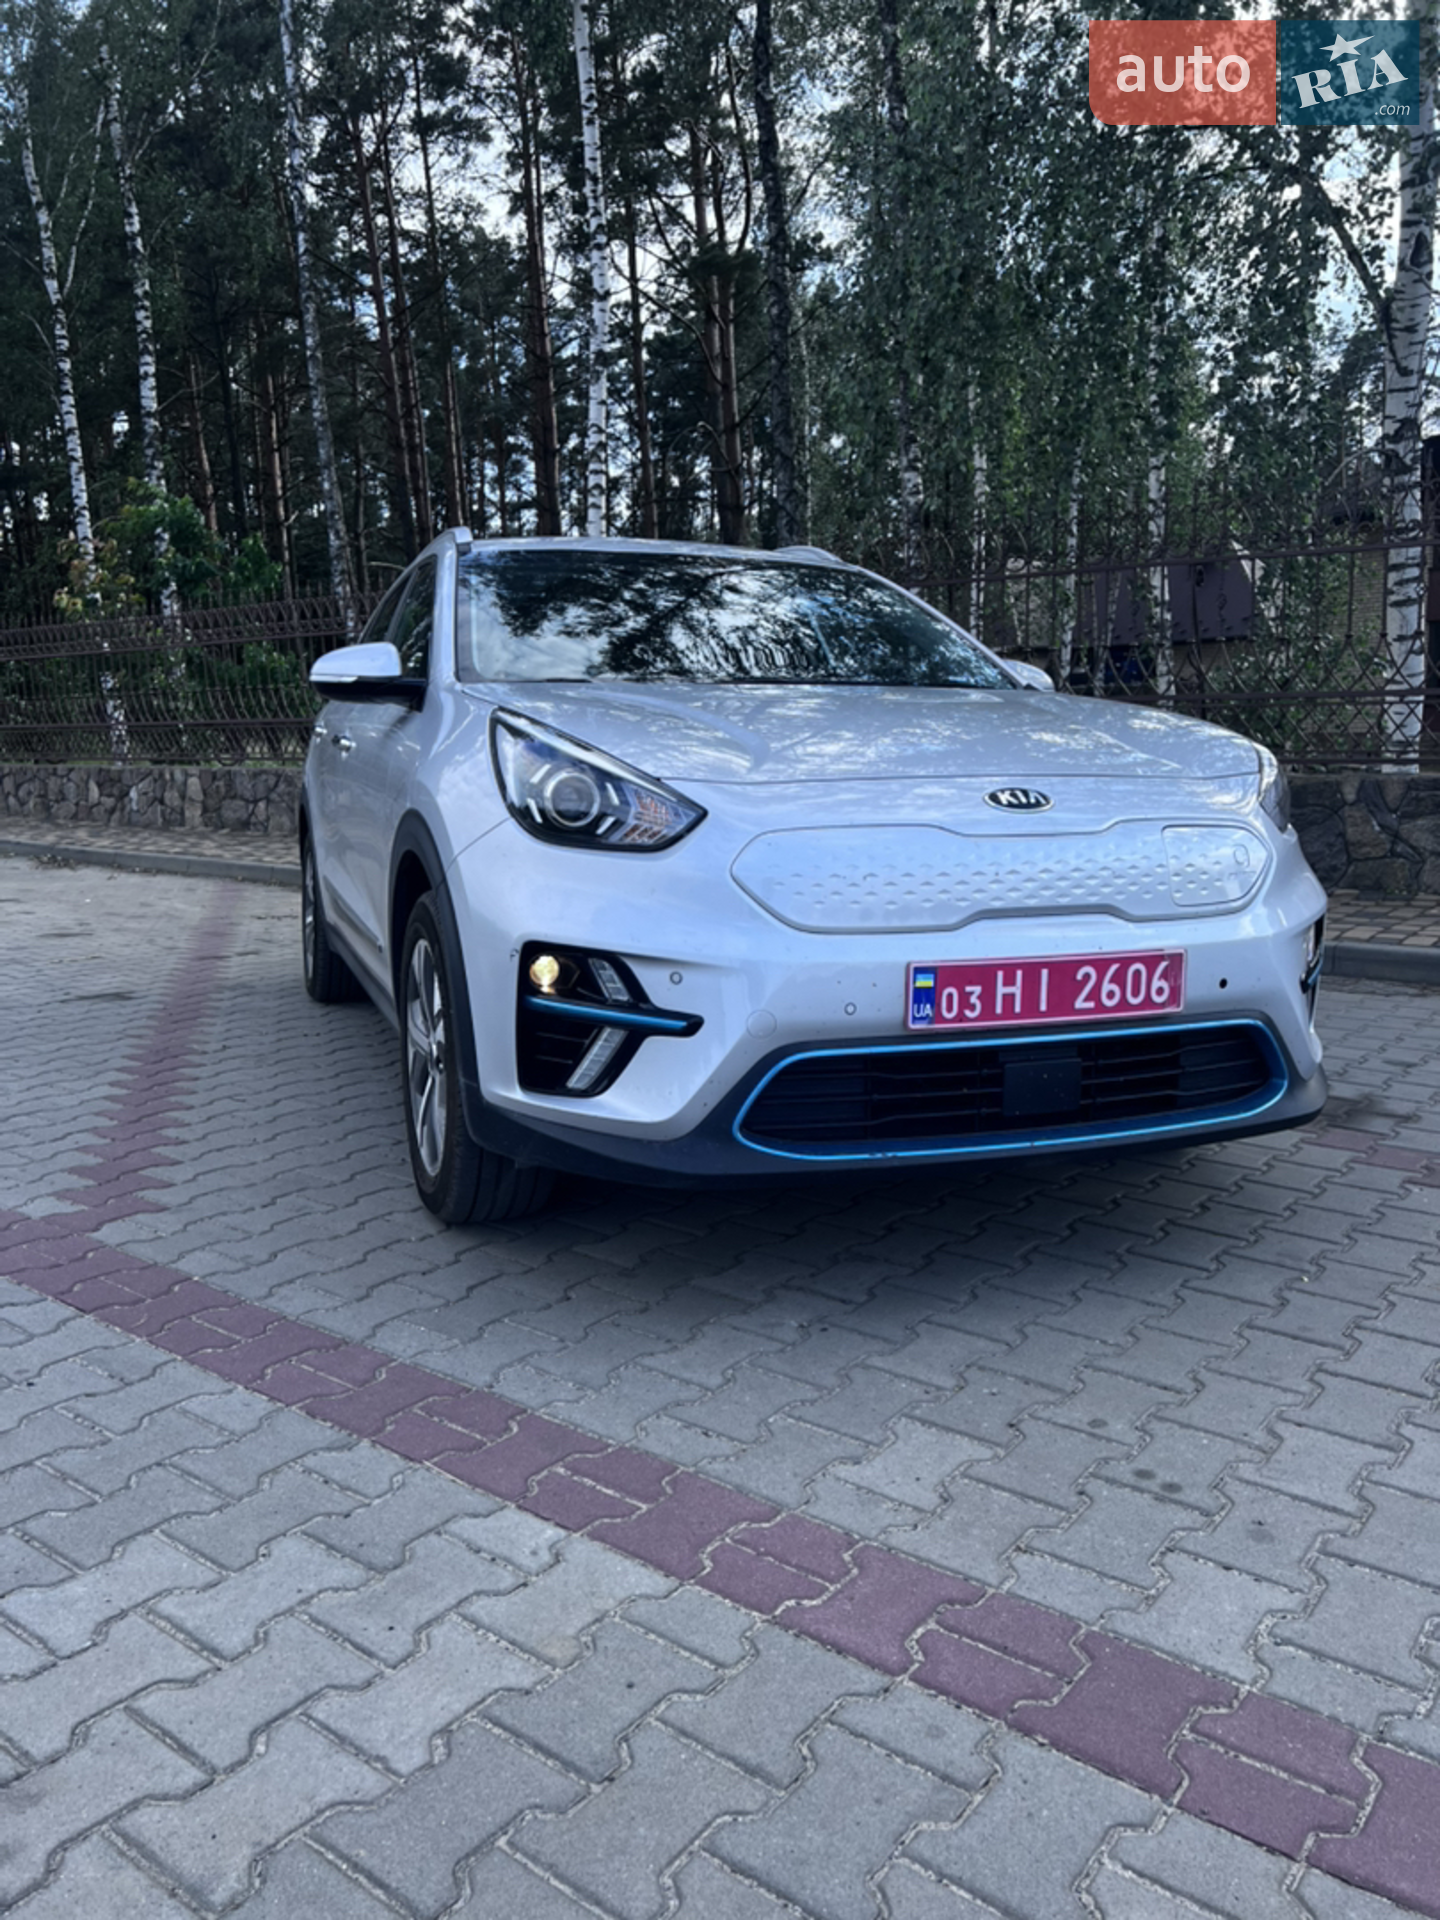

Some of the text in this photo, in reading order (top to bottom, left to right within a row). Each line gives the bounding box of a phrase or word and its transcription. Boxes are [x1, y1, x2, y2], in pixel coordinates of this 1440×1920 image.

[996, 790, 1048, 805] KIA
[941, 961, 1170, 1019] 03 HI 2606
[913, 1003, 933, 1017] UA
